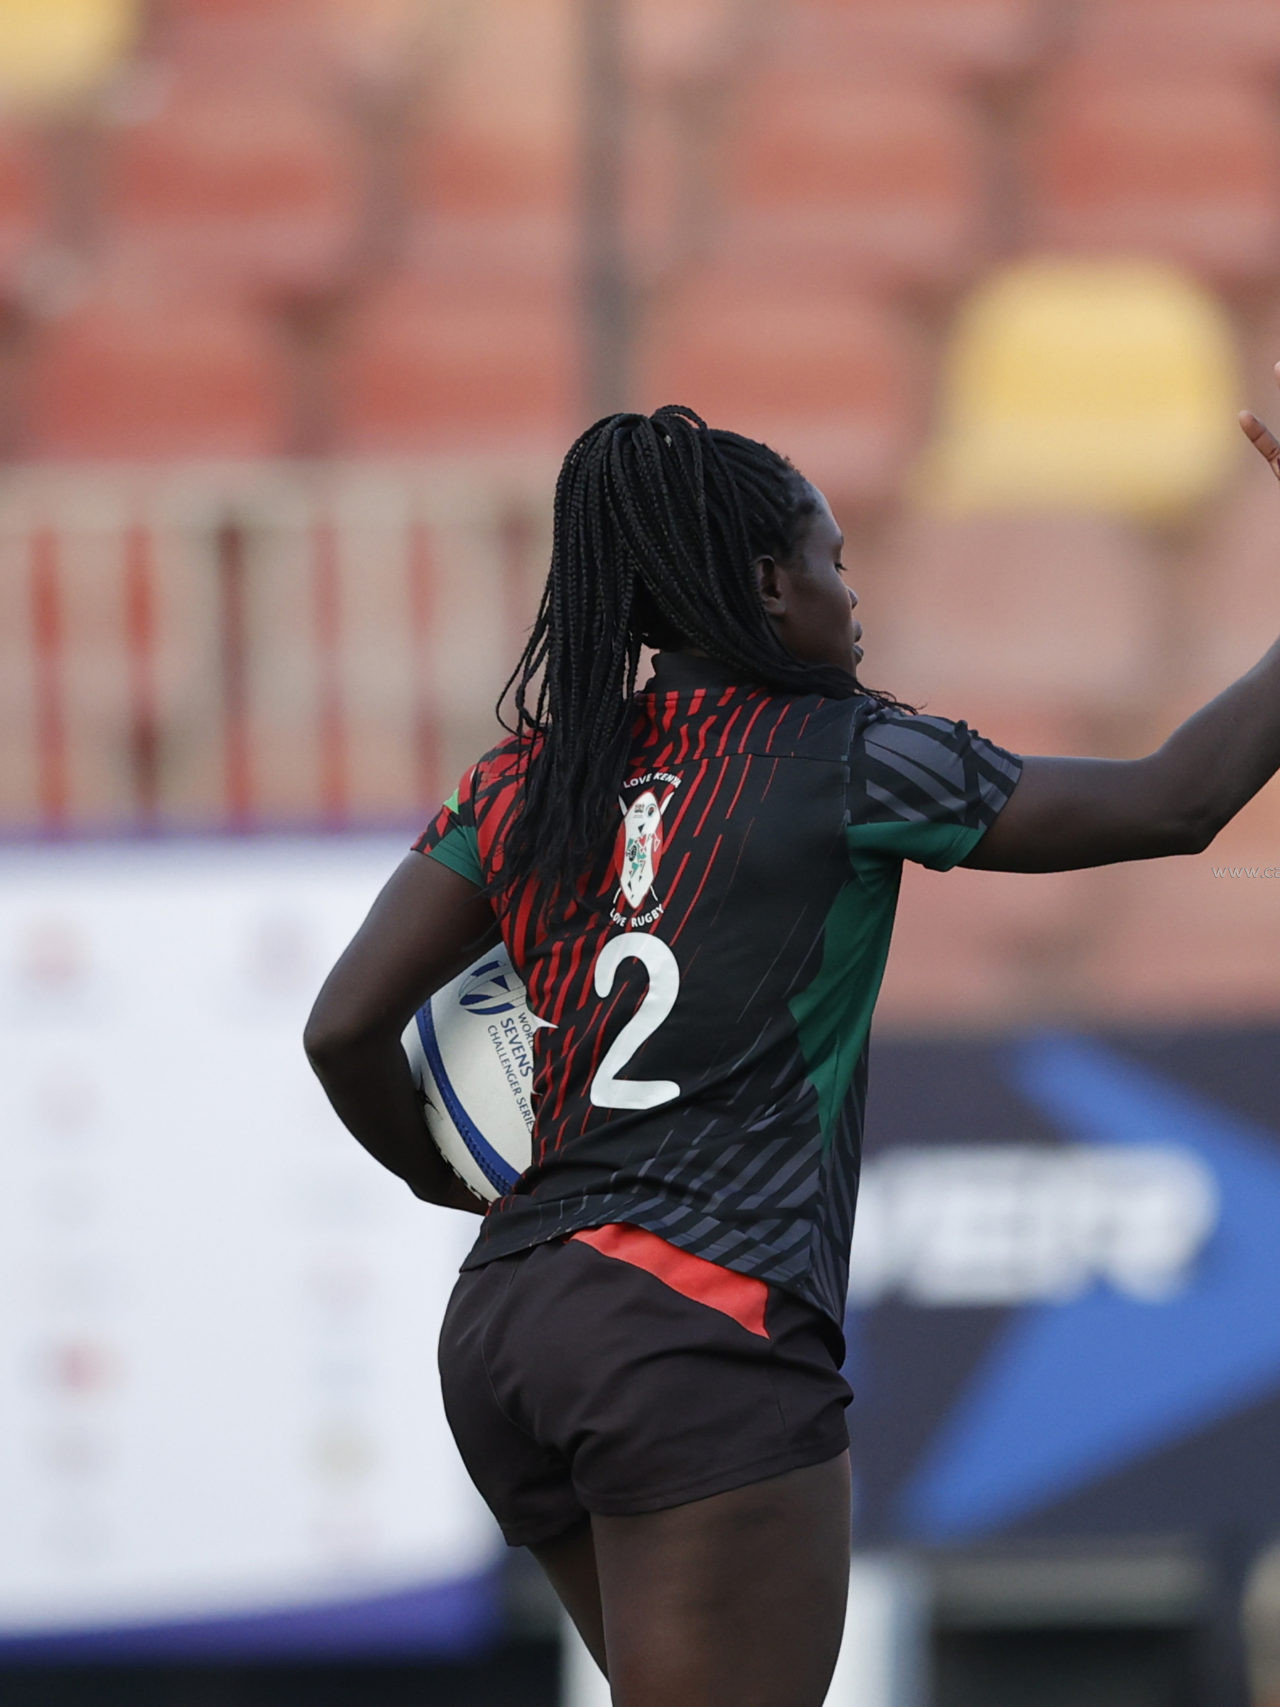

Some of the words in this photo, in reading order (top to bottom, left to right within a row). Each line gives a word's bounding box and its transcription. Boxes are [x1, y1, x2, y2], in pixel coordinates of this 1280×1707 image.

[623, 773, 651, 789] LOVE
[653, 771, 682, 788] KENYA
[609, 908, 627, 927] LOVE
[631, 904, 664, 928] RUGBY
[517, 1012, 534, 1050] WORL
[590, 932, 680, 1110] 2
[487, 1025, 522, 1096] CHALLENGER
[500, 1017, 534, 1078] SEVENS
